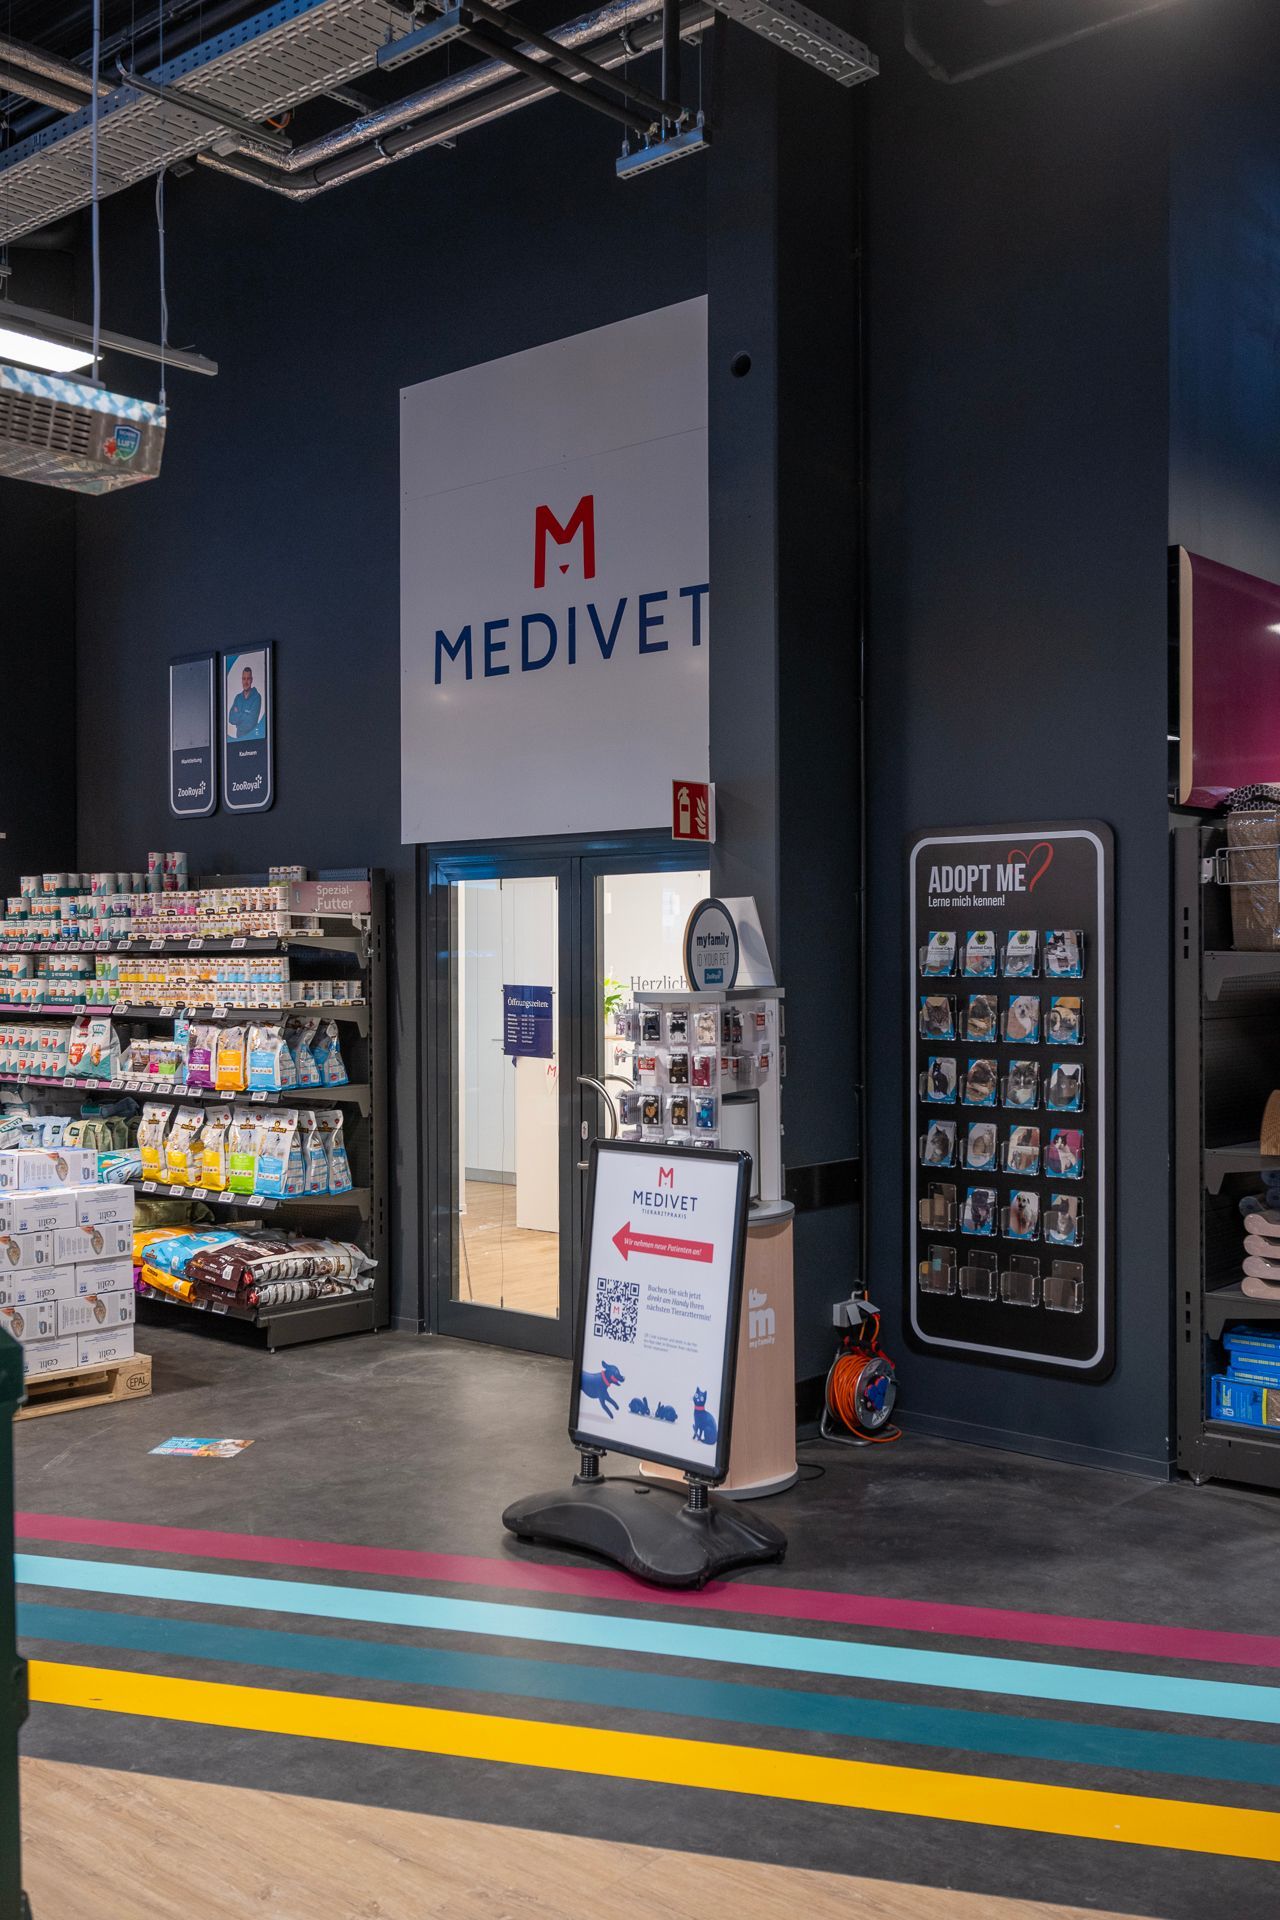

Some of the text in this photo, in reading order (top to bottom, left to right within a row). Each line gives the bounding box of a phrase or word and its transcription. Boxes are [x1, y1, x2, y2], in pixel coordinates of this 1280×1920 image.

[534, 494, 596, 589] M
[434, 582, 709, 685] MEDIVET
[177, 786, 204, 798] ZooRoyal
[232, 779, 260, 792] ZooRoyal
[928, 863, 1026, 893] ADOPT ME
[316, 884, 353, 896] Spezial-
[317, 897, 353, 910] Futter
[928, 894, 1005, 908] Lerne mich kennen!
[696, 931, 730, 948] myfamily
[631, 975, 688, 991] Herzlich
[658, 1166, 674, 1188] M
[632, 1190, 698, 1212] MEDIVET
[624, 1237, 633, 1245] Wir
[633, 1239, 654, 1249] nehmen
[667, 1243, 692, 1254] Patienten
[647, 1284, 701, 1300] Buchen Sie sich jetzt
[646, 1293, 662, 1303] direkt
[671, 1298, 690, 1308] Handy
[690, 1301, 705, 1311] Ihren
[646, 1304, 671, 1313] nächsten
[128, 1375, 148, 1388] EPAL
